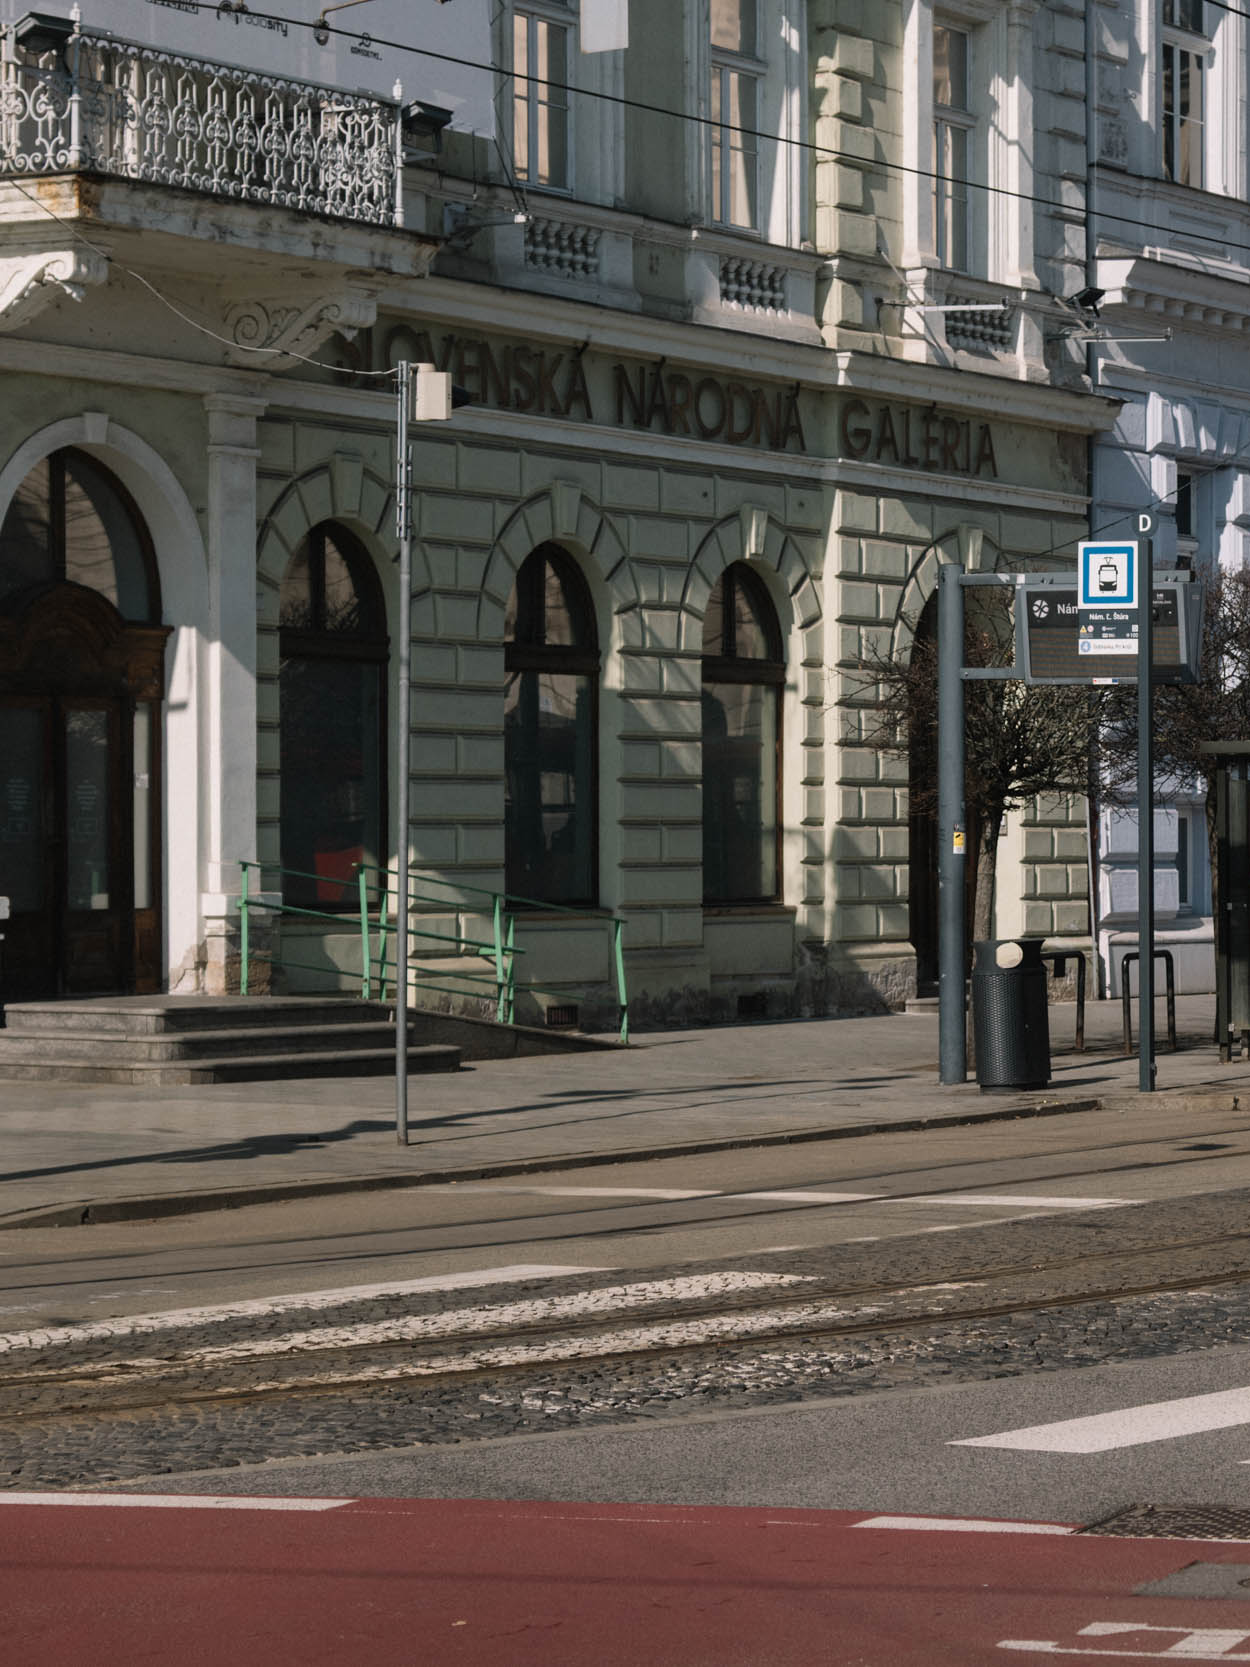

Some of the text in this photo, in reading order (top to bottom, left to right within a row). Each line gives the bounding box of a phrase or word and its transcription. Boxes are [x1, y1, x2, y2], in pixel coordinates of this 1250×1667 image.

[613, 356, 807, 451] NÁRODNÁ
[842, 401, 999, 478] GALÉRIA
[1138, 514, 1151, 532] D
